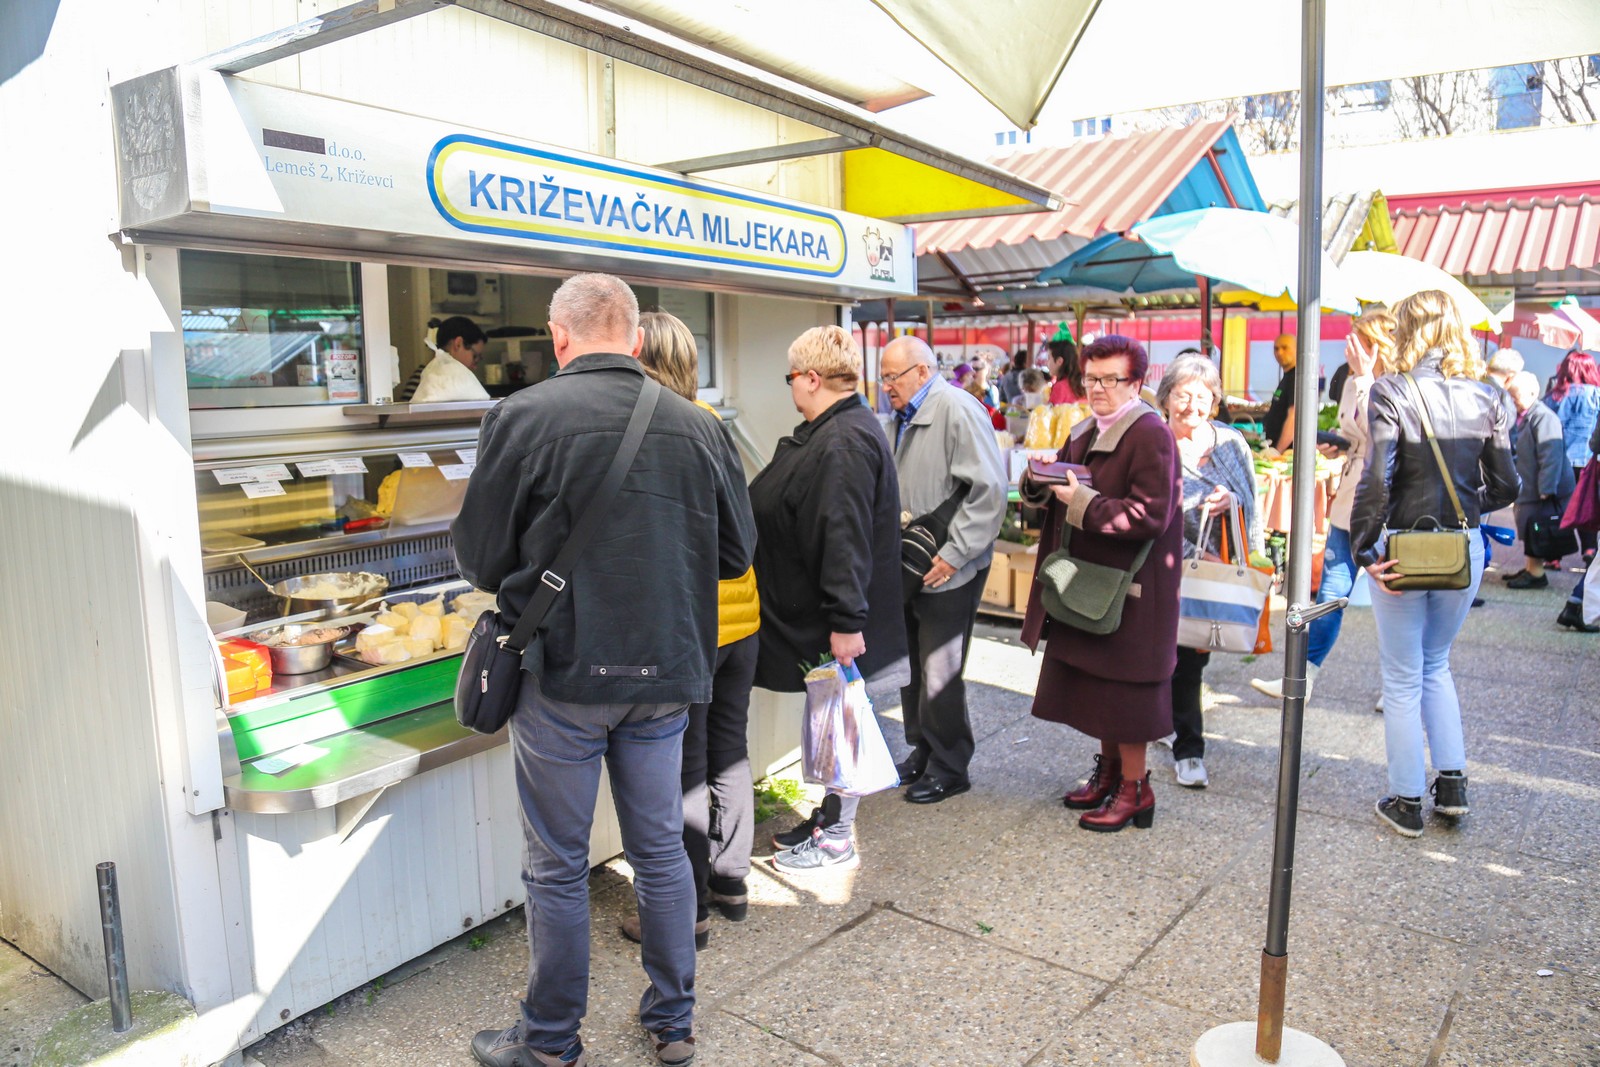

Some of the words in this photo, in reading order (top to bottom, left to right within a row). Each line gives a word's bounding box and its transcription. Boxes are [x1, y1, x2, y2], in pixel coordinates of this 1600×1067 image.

[328, 141, 366, 161] d.o.o.
[265, 155, 316, 178] Lemeš
[320, 164, 333, 183] 2,
[337, 166, 394, 189] Križevci
[468, 169, 695, 240] KRIŽEVAČKA
[702, 212, 830, 261] MLJEKARA
